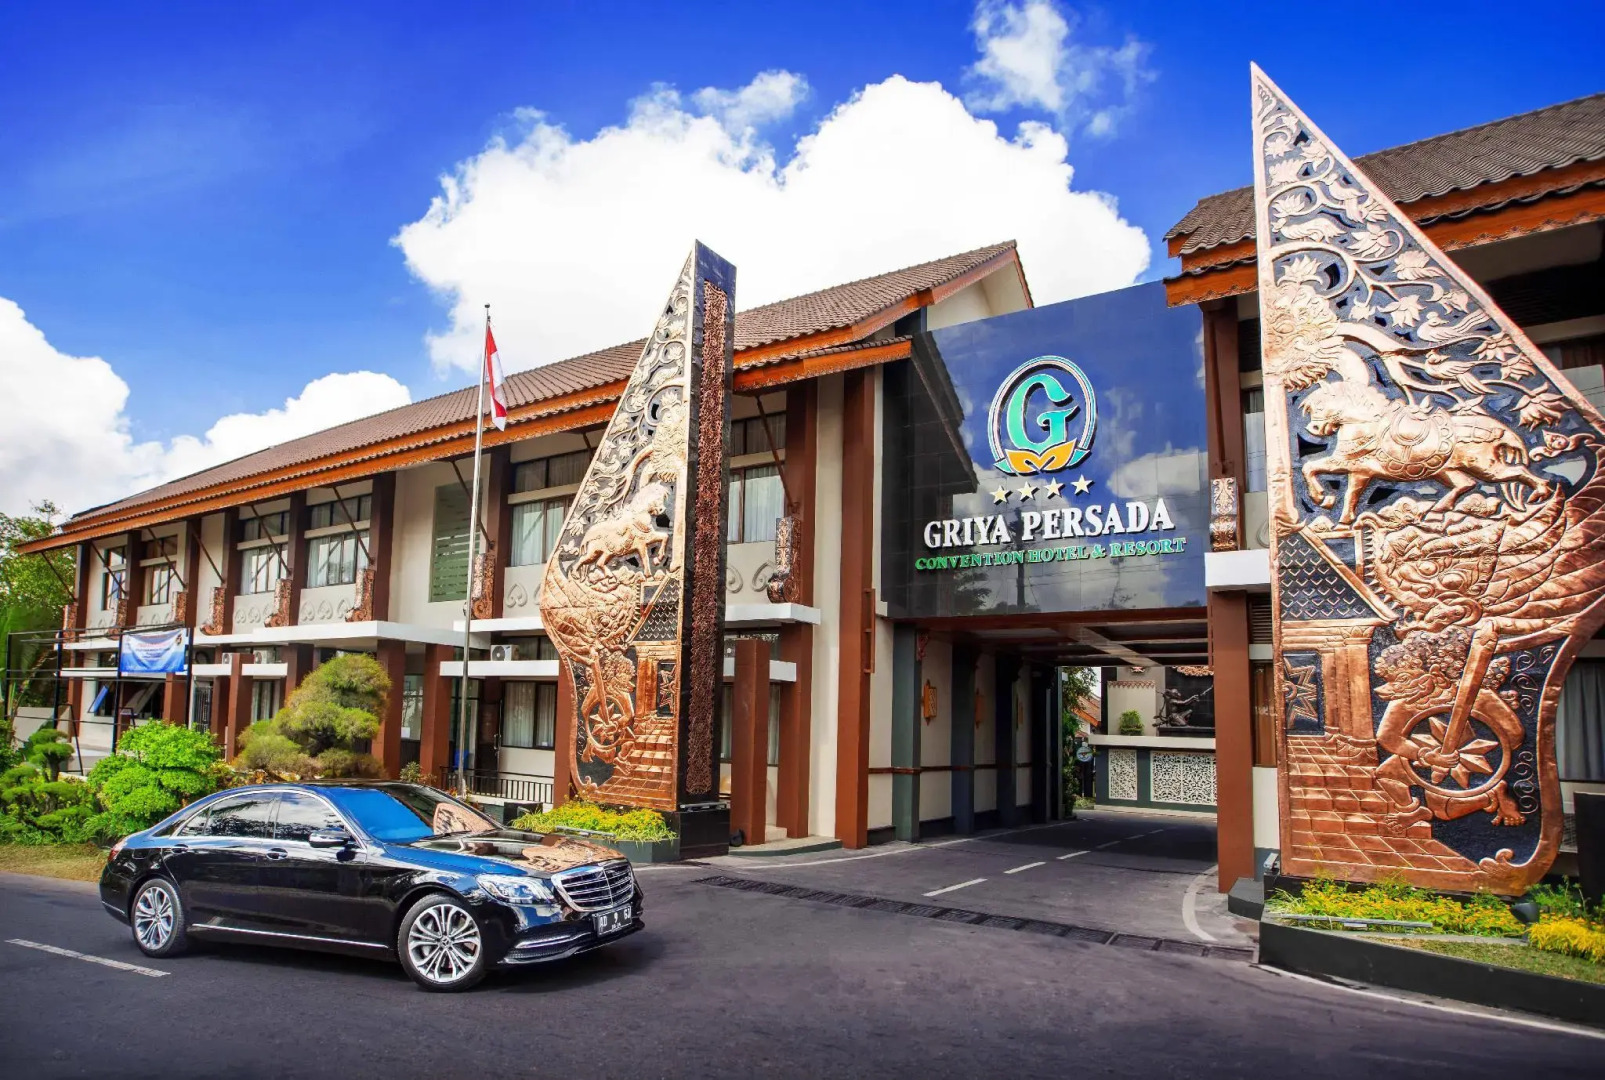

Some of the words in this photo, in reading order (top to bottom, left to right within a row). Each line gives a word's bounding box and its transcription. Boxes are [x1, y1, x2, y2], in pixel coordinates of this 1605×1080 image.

[1006, 373, 1079, 453] G
[924, 514, 1011, 548] GRIYA
[1021, 498, 1175, 541] PERSADA
[915, 550, 1025, 570] CONVENTION
[1028, 545, 1089, 563] HOTEL
[1091, 544, 1106, 559] &
[1109, 537, 1187, 558] RESORT
